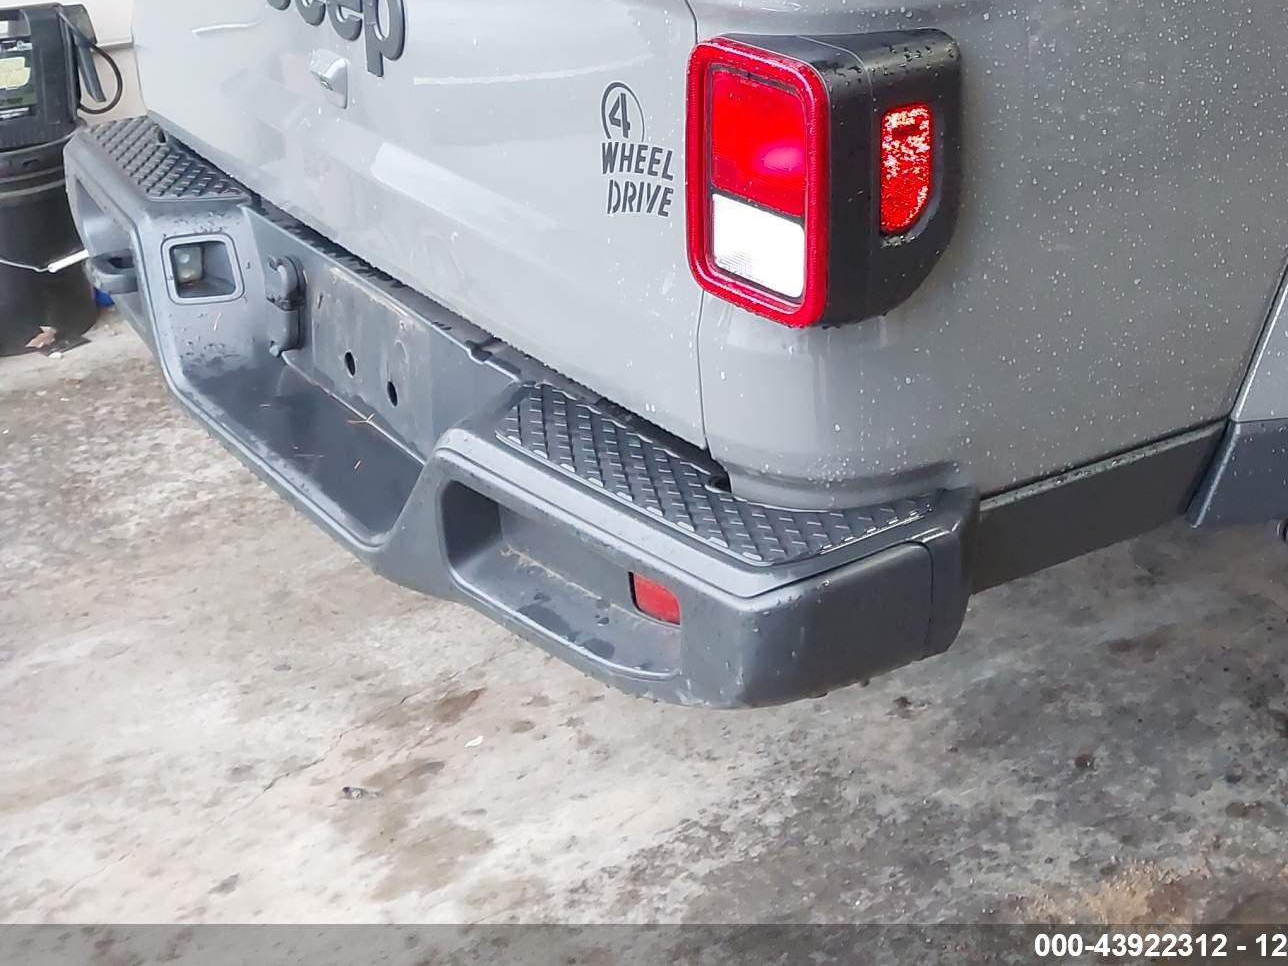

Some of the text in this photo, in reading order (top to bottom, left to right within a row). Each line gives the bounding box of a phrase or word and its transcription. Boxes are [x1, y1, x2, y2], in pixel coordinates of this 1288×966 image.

[608, 92, 631, 139] 4
[601, 141, 675, 182] WHEEL
[607, 180, 675, 219] DRIVE
